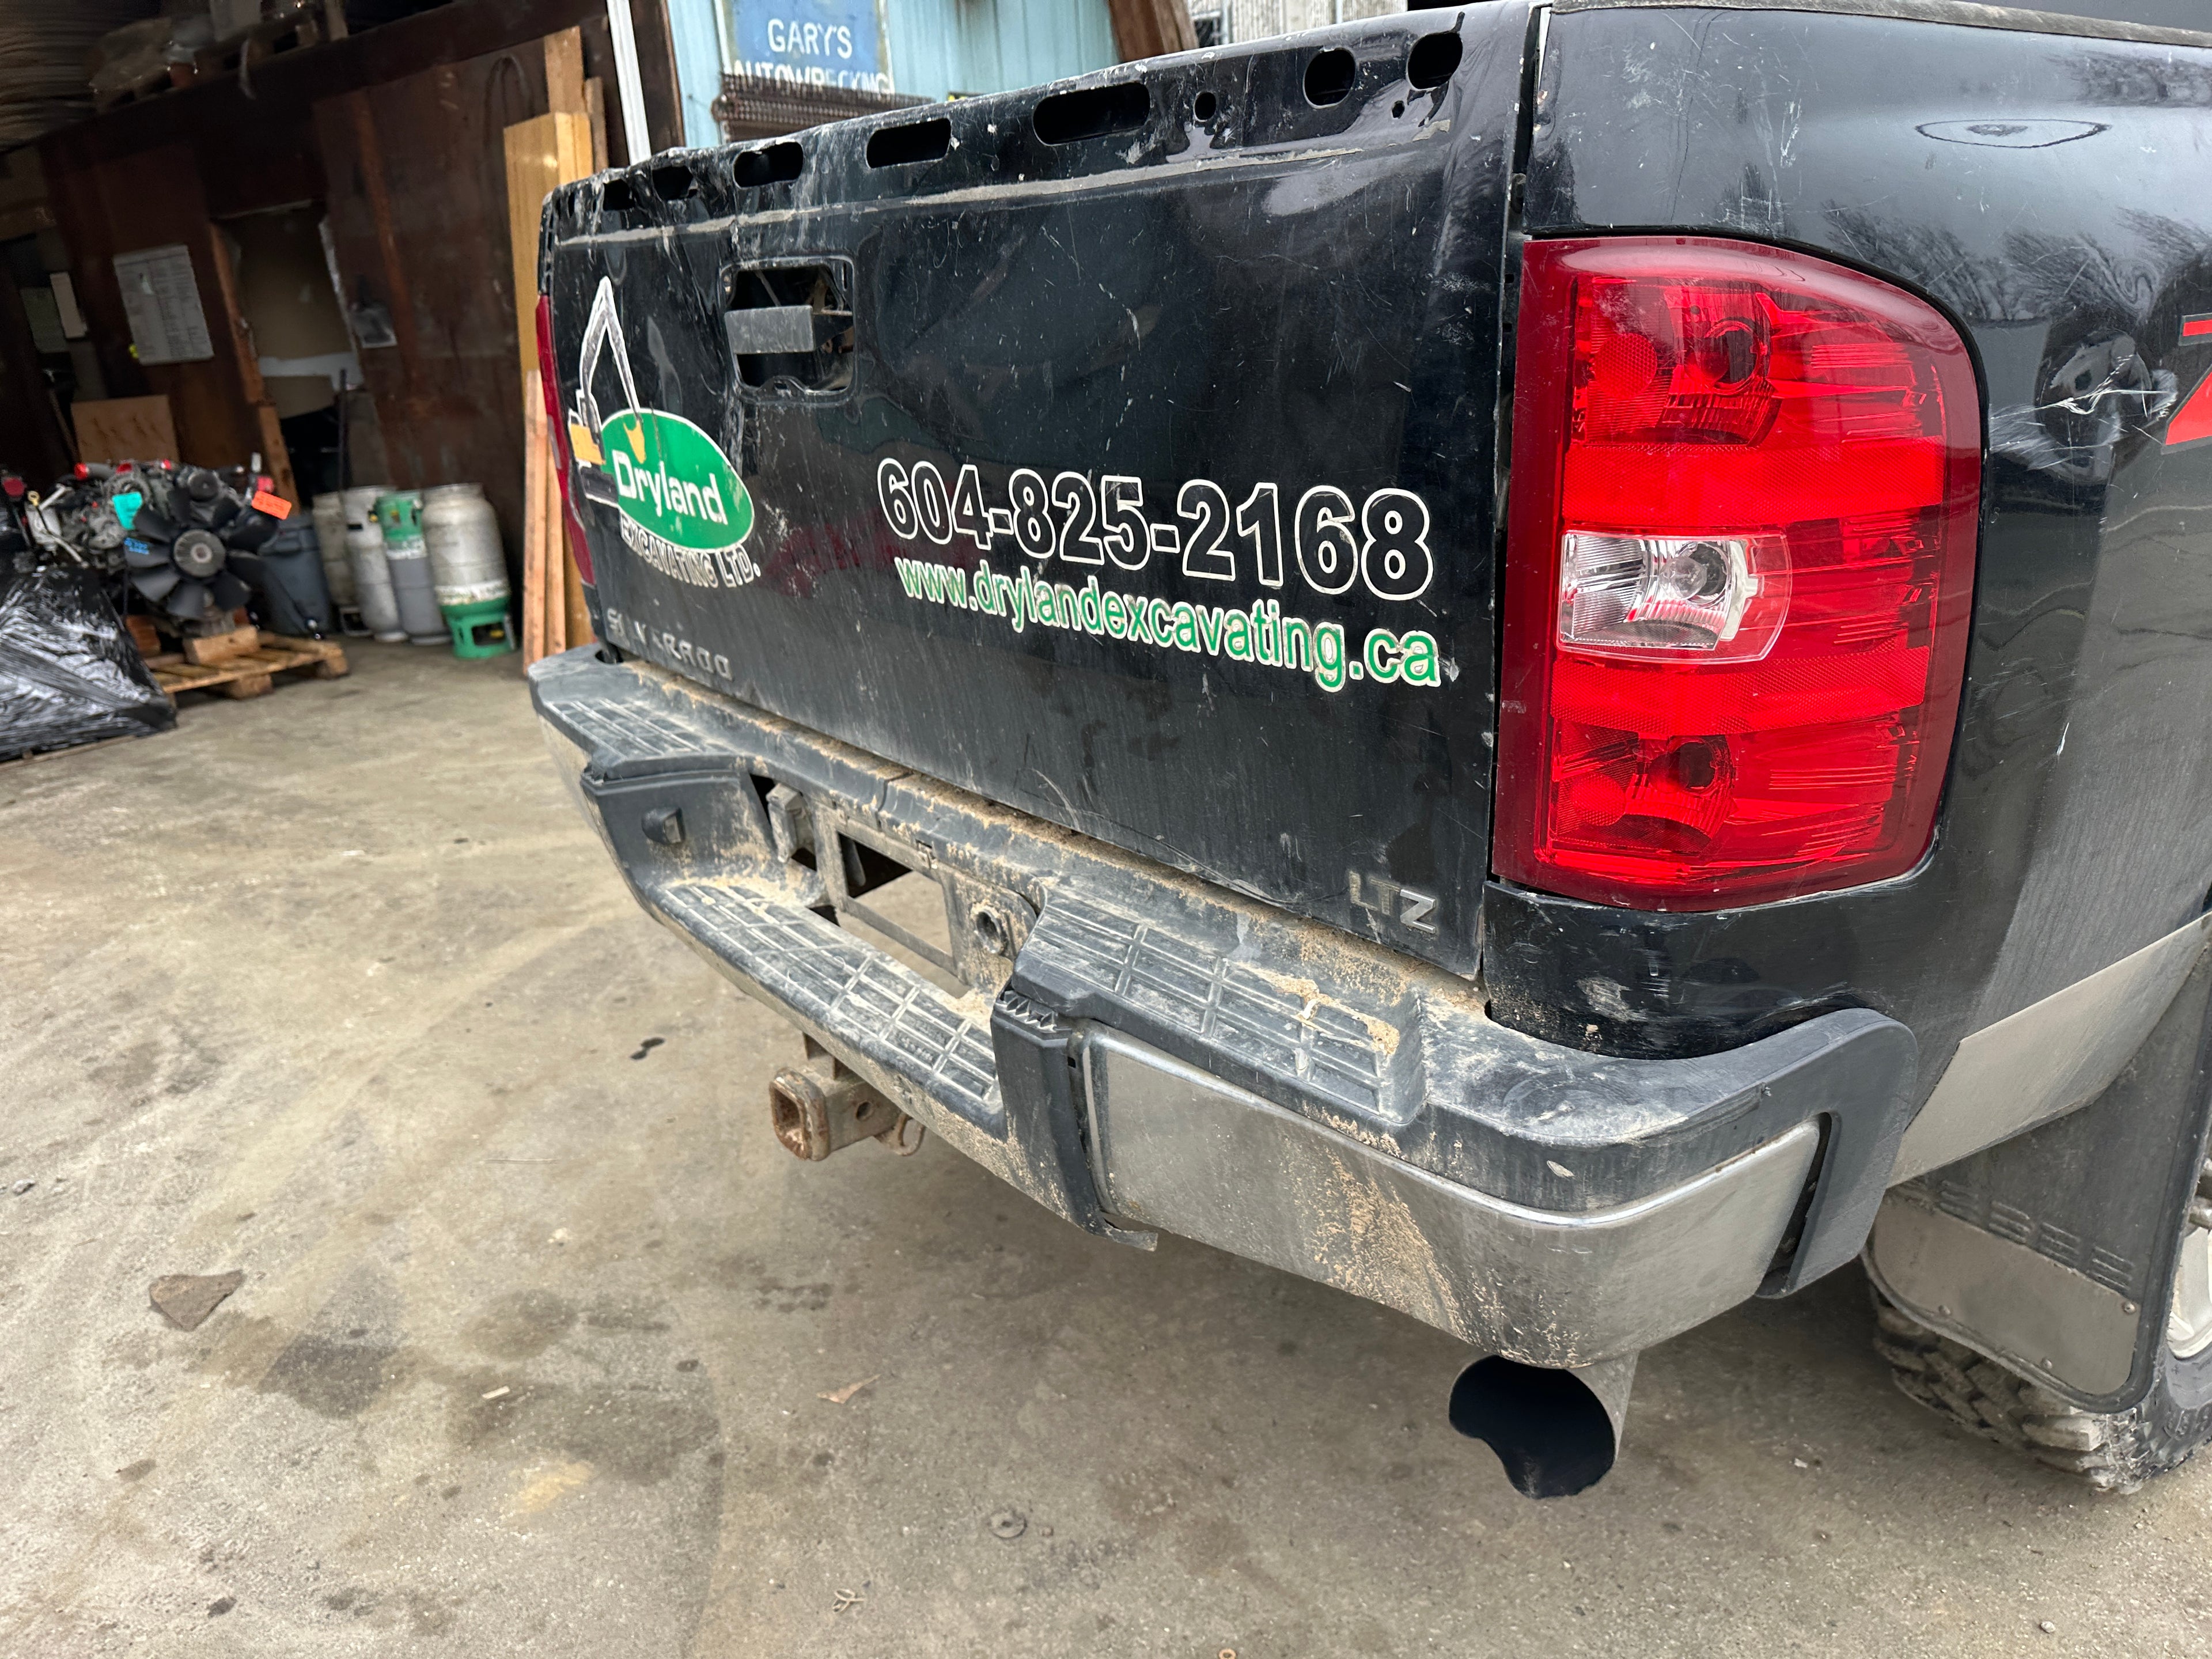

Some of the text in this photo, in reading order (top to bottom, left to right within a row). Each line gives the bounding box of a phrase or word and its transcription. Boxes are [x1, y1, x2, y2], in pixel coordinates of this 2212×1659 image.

[767, 18, 853, 59] GARY'S
[612, 450, 728, 525] Dryland
[619, 512, 762, 589] EXCAVATING LTD.
[877, 457, 1434, 600] 604-825-2168
[607, 607, 733, 683] SVRADO
[893, 556, 1441, 693] www.drylandexcavating.ca
[1348, 869, 1437, 934] LTZ
